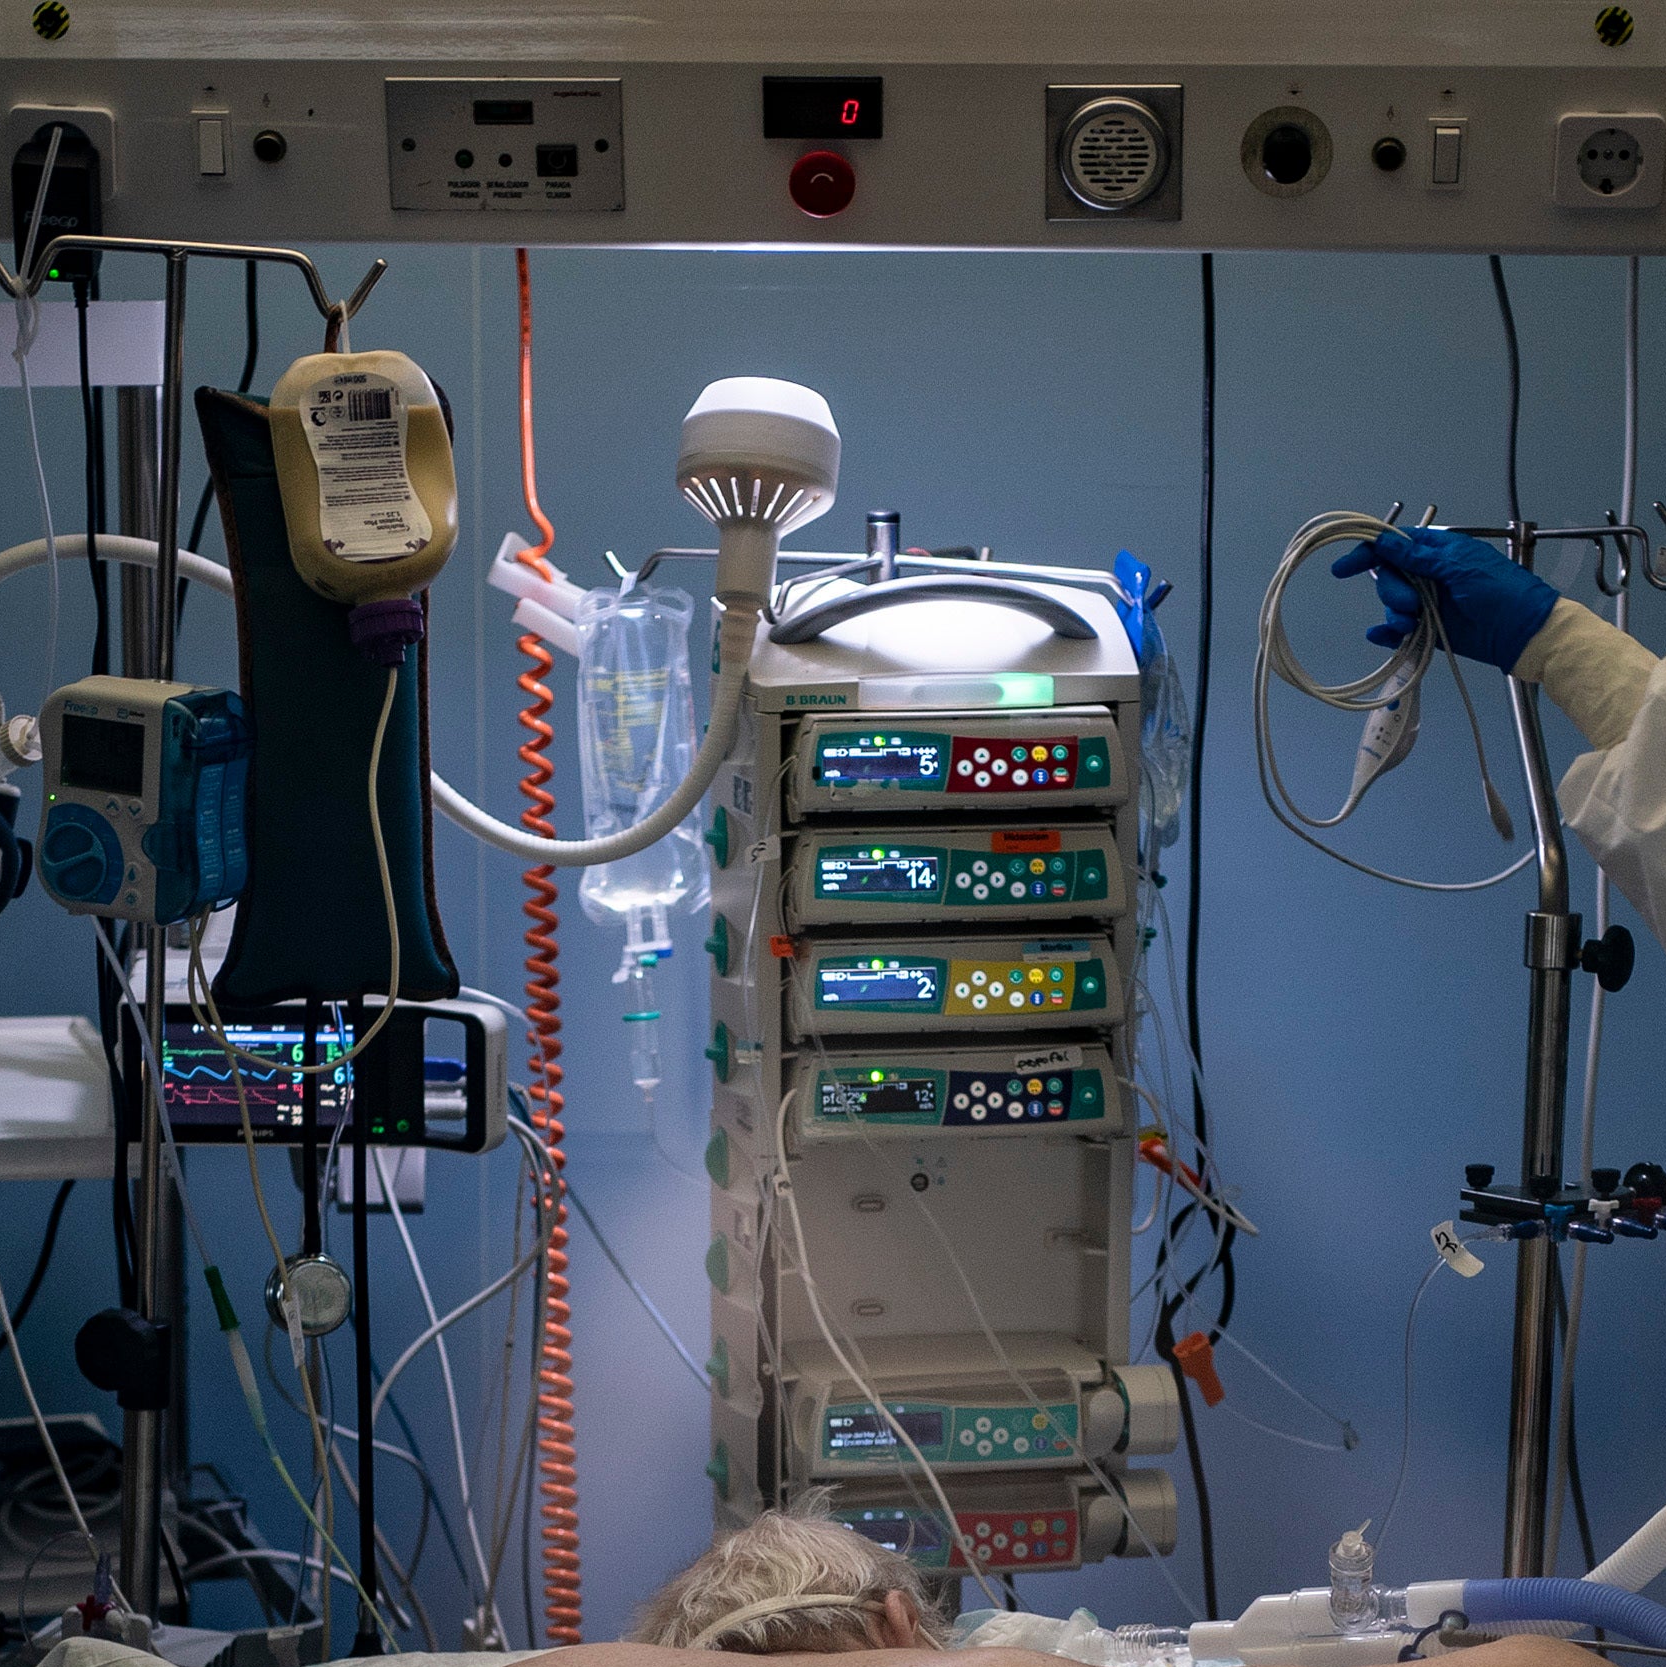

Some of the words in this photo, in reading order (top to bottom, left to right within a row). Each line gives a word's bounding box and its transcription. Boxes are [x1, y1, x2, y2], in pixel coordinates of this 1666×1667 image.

[840, 99, 859, 125] 0
[800, 694, 847, 705] BRAUN
[919, 754, 934, 775] 5
[906, 867, 931, 889] 14
[917, 977, 932, 999] 2
